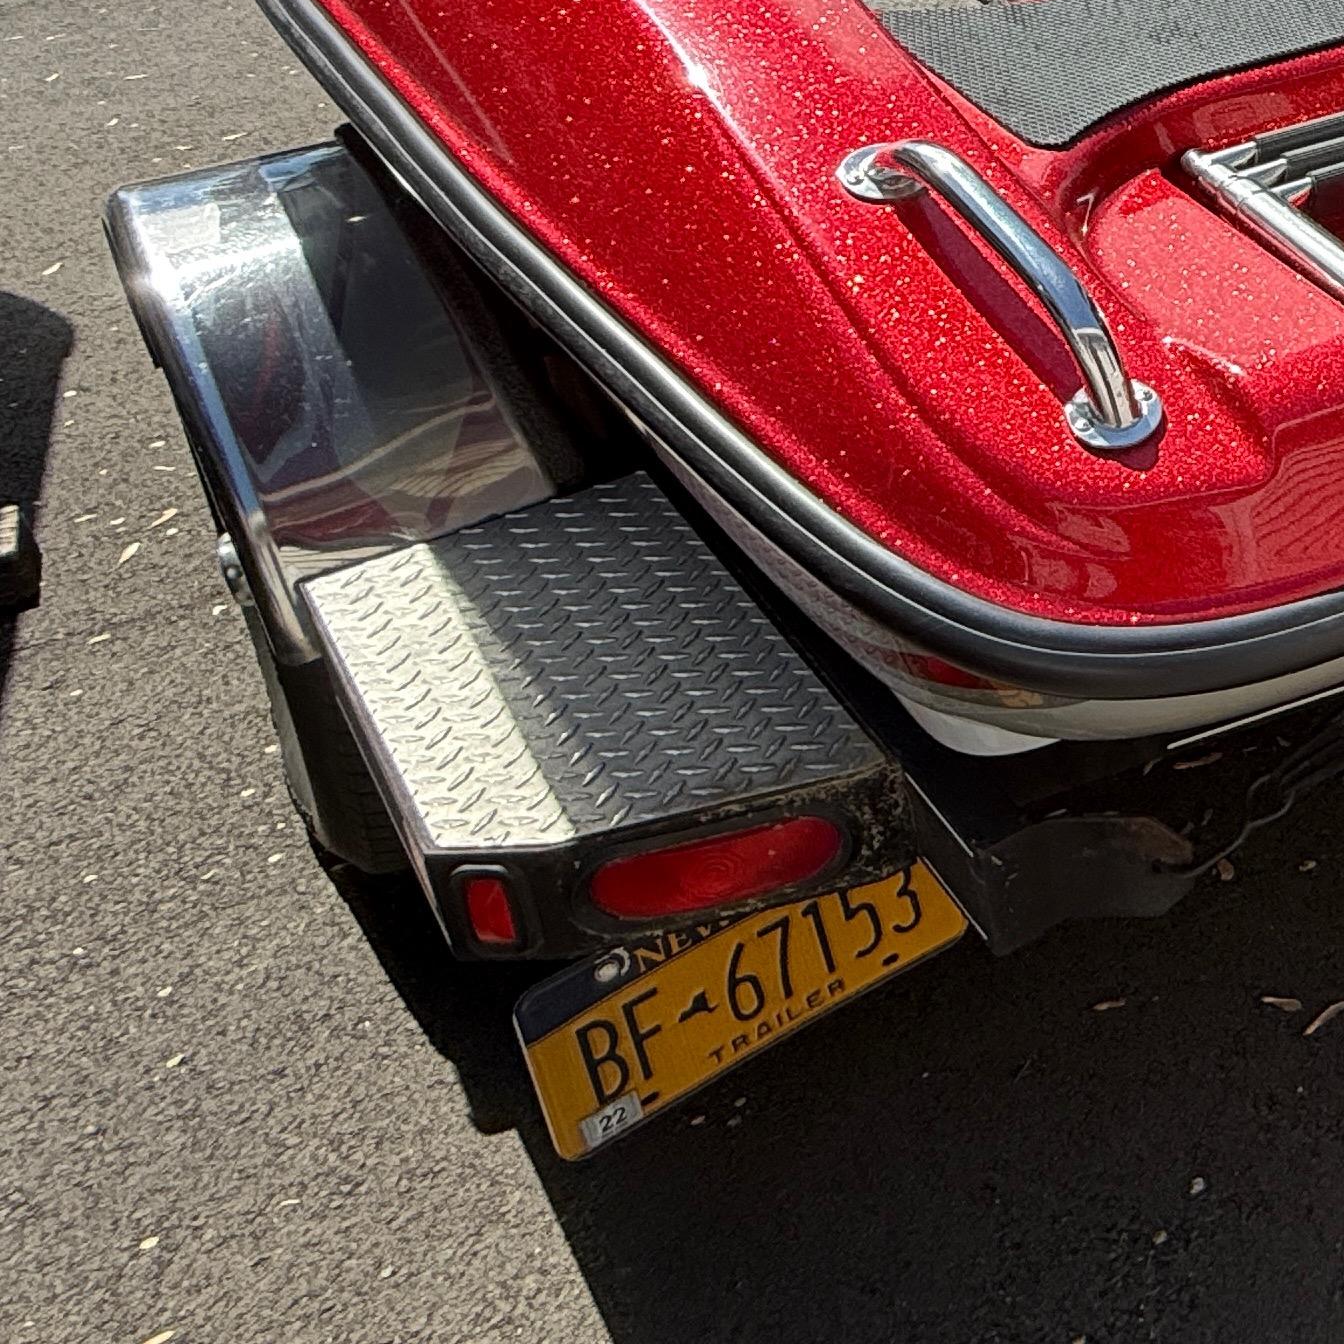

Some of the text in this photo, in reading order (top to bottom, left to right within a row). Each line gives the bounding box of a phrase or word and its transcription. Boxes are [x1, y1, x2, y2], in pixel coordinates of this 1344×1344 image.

[574, 868, 924, 1104] BF 67153
[708, 978, 847, 1065] TRAILER
[599, 1107, 627, 1133] 22
